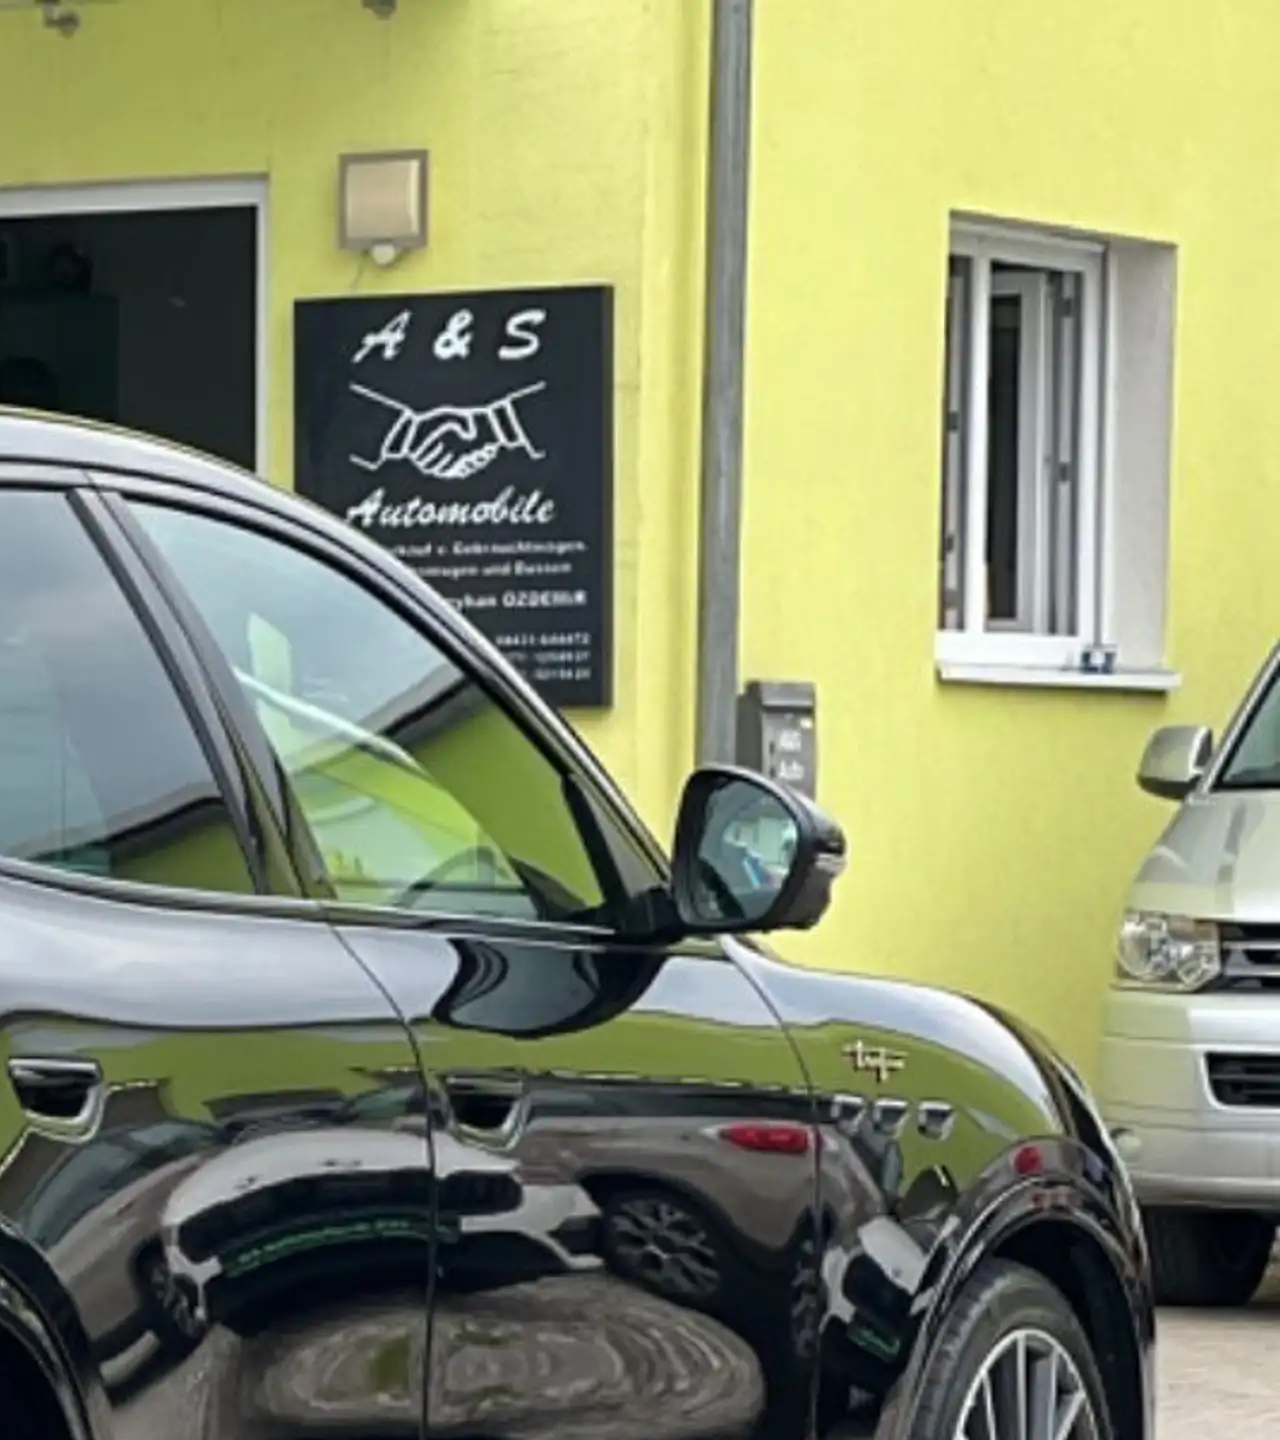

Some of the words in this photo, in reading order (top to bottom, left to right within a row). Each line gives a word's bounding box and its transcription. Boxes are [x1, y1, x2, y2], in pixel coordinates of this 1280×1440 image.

[352, 309, 412, 362] A
[433, 309, 473, 359] &
[498, 309, 546, 360] S
[345, 485, 555, 528] Automobile
